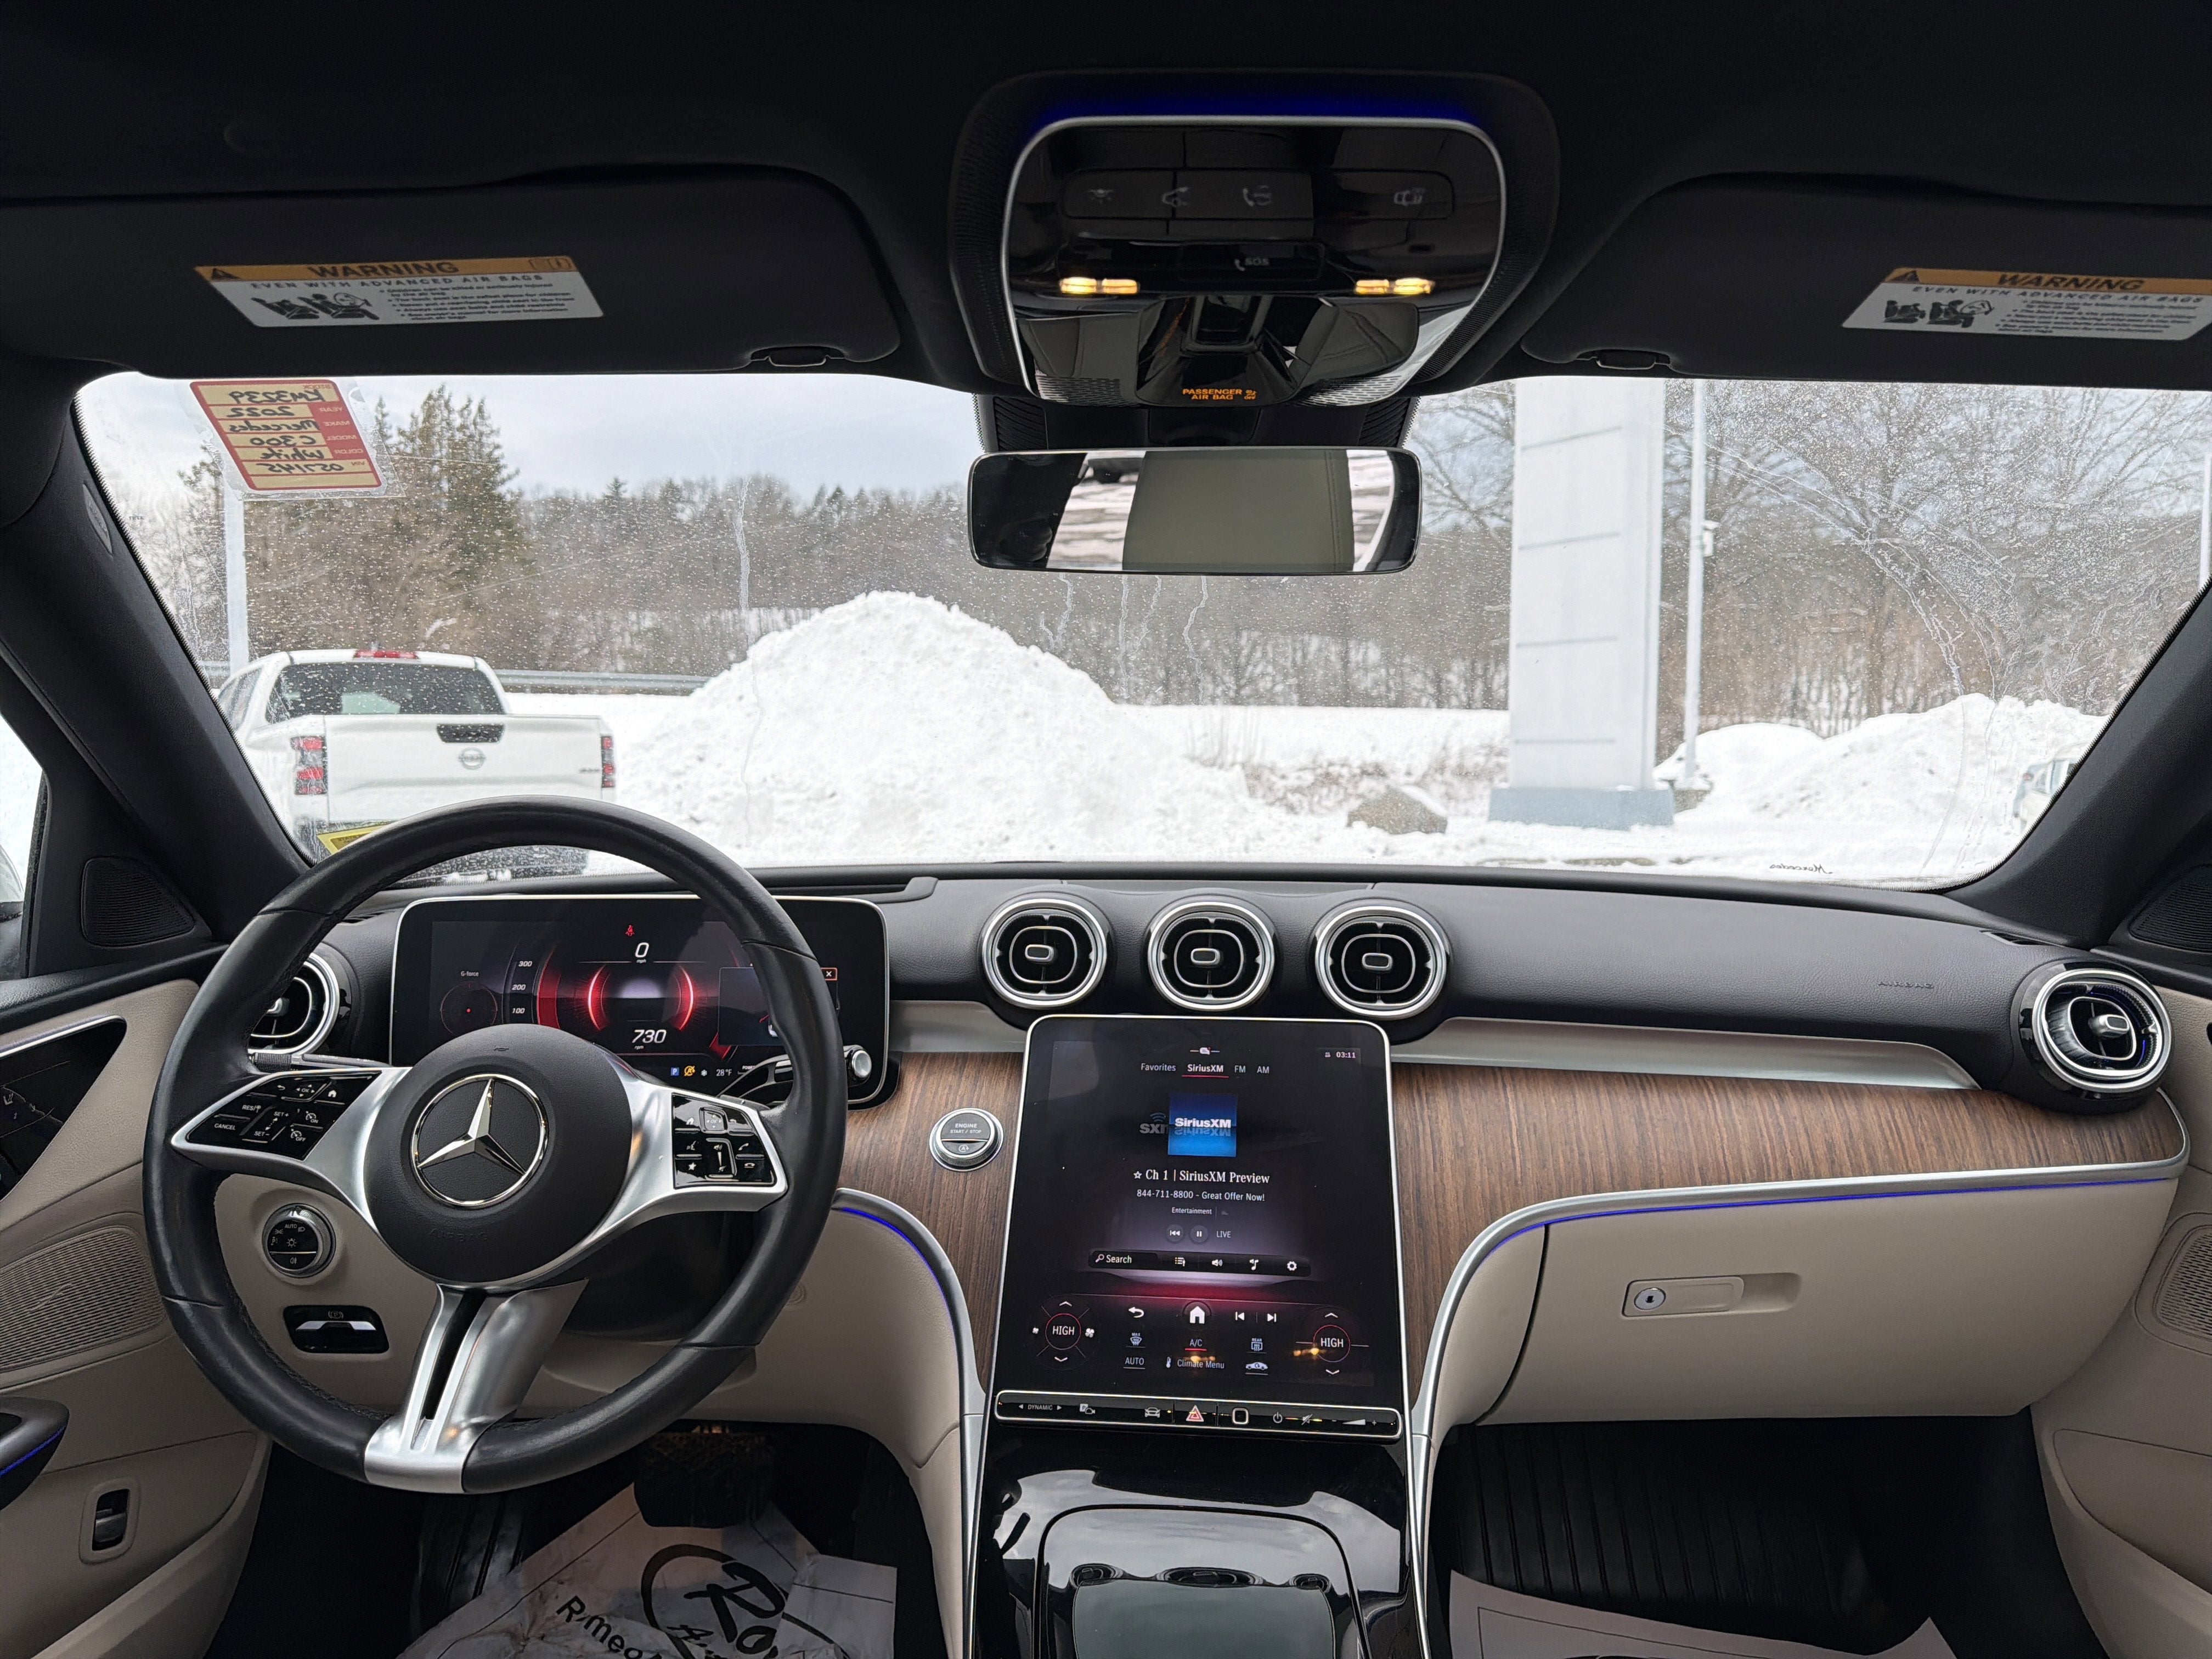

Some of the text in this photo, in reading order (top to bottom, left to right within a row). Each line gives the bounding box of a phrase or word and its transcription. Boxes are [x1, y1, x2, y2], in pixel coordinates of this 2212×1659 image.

[1245, 257, 1269, 266] SOS
[307, 262, 459, 278] WARNING
[360, 278, 453, 287] ADVANCED
[1996, 274, 2146, 291] WARNING
[2017, 290, 2113, 300] ADVANCED
[635, 942, 649, 957] 0
[631, 1029, 667, 1043] 730
[1141, 1063, 1176, 1071] Favorites
[1187, 1064, 1224, 1073] SiriusXM
[1175, 1118, 1232, 1128] SiriusXM
[1146, 1169, 1159, 1180] Ch
[1163, 1170, 1168, 1180] 1
[1179, 1170, 1226, 1182] SiriusXM
[1229, 1172, 1270, 1183] Preview
[1137, 1189, 1194, 1199] 844-711-8800
[1201, 1191, 1222, 1200] Great
[1224, 1192, 1243, 1200] Offer
[1246, 1193, 1265, 1201] Now!
[1171, 1207, 1212, 1215] Entertainment
[1106, 1254, 1132, 1265] Search
[1052, 1325, 1075, 1336] HIGH
[1189, 1339, 1203, 1347] A/C
[1321, 1337, 1344, 1348] HIGH
[1125, 1357, 1144, 1365] AUTO
[1177, 1358, 1224, 1369] Climate Menu
